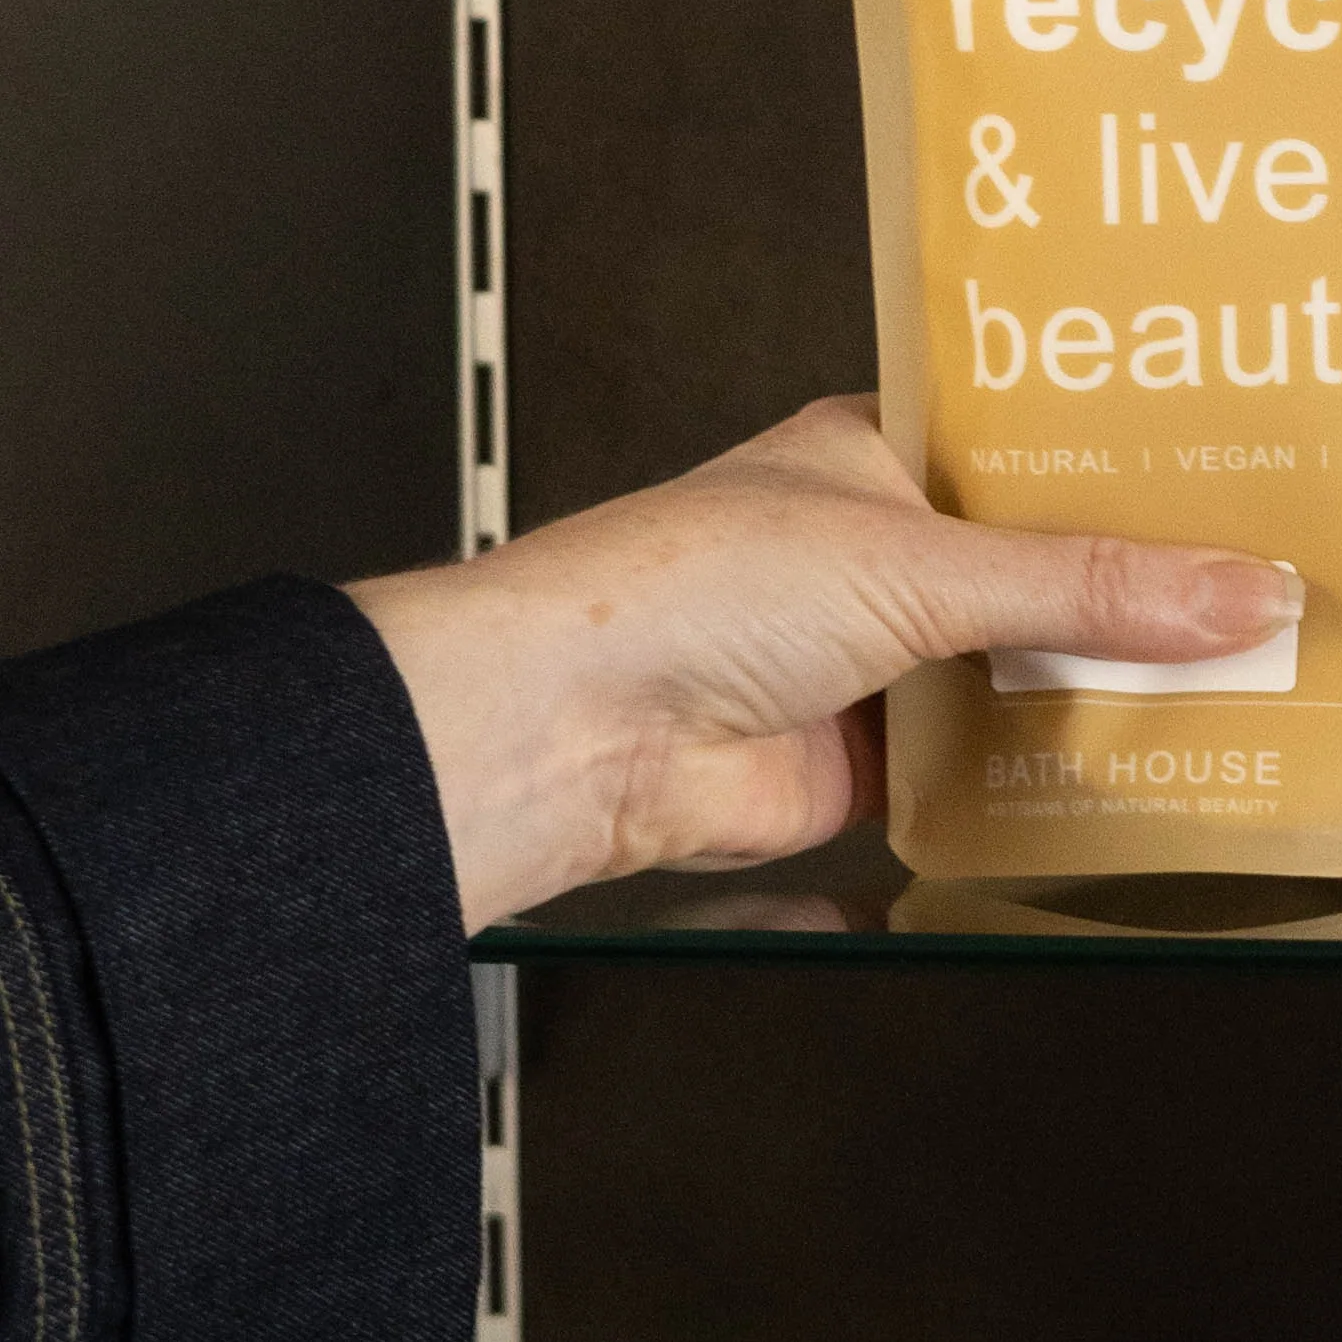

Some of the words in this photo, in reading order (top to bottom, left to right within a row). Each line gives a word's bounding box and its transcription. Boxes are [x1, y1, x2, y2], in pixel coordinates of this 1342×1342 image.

[964, 113, 1041, 230] &
[1101, 112, 1330, 226] live
[970, 448, 1119, 476] NATURAL
[1176, 444, 1296, 472] VEGAN
[985, 751, 1082, 788] BATH
[1108, 749, 1282, 786] HOUSE
[1101, 797, 1190, 815] NATURAL
[1199, 797, 1280, 815] BEAUTY
